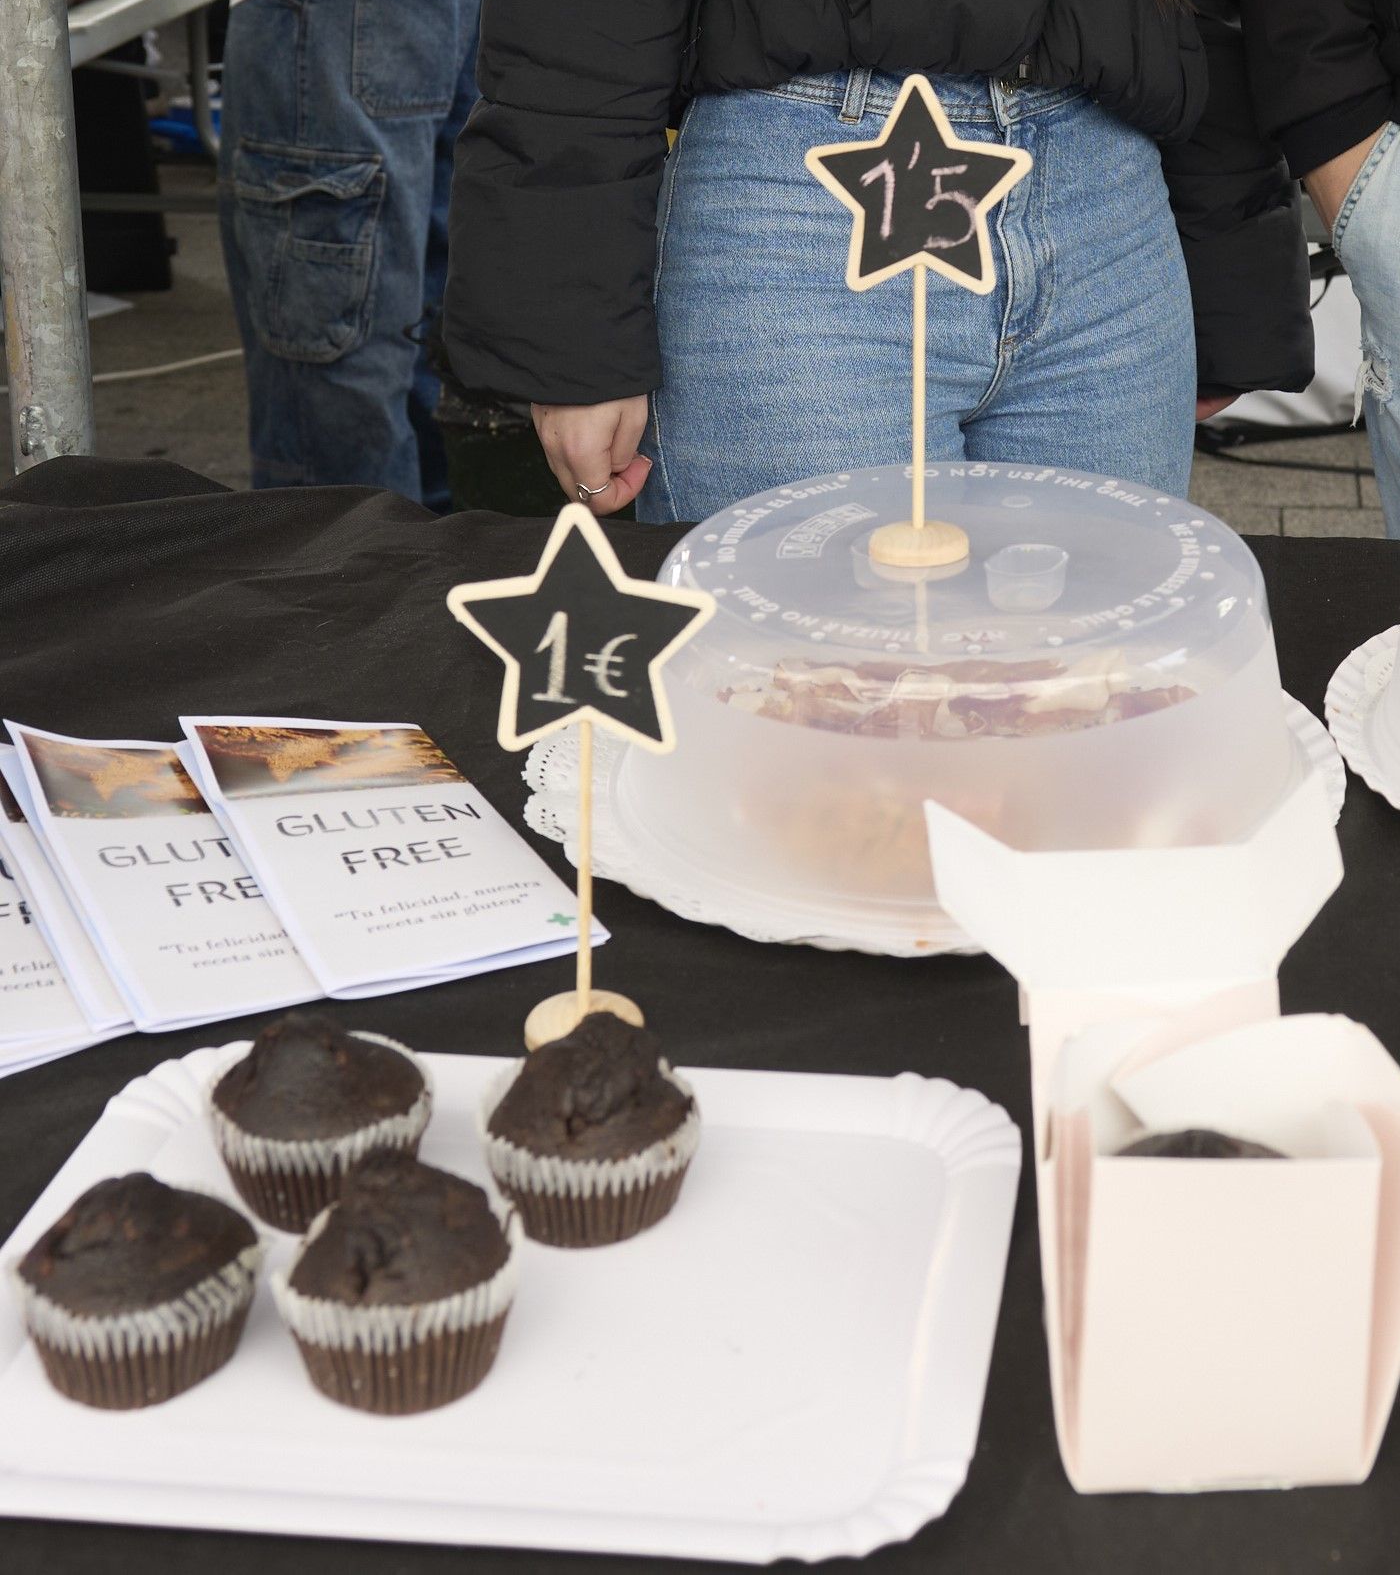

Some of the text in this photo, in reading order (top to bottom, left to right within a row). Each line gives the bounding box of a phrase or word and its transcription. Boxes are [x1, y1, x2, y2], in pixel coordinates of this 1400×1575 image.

[791, 481, 848, 500] GRILL
[950, 467, 999, 478] NOT
[1008, 470, 1048, 482] USE
[1053, 475, 1094, 490] THE
[1096, 483, 1148, 507] GRILL
[275, 802, 482, 838] GLUTEN
[97, 836, 231, 868] GLUT
[341, 836, 472, 875] FREE
[164, 875, 265, 908] FRE
[366, 916, 425, 934] receta
[430, 909, 457, 921] sin
[192, 946, 285, 969] receta sin
